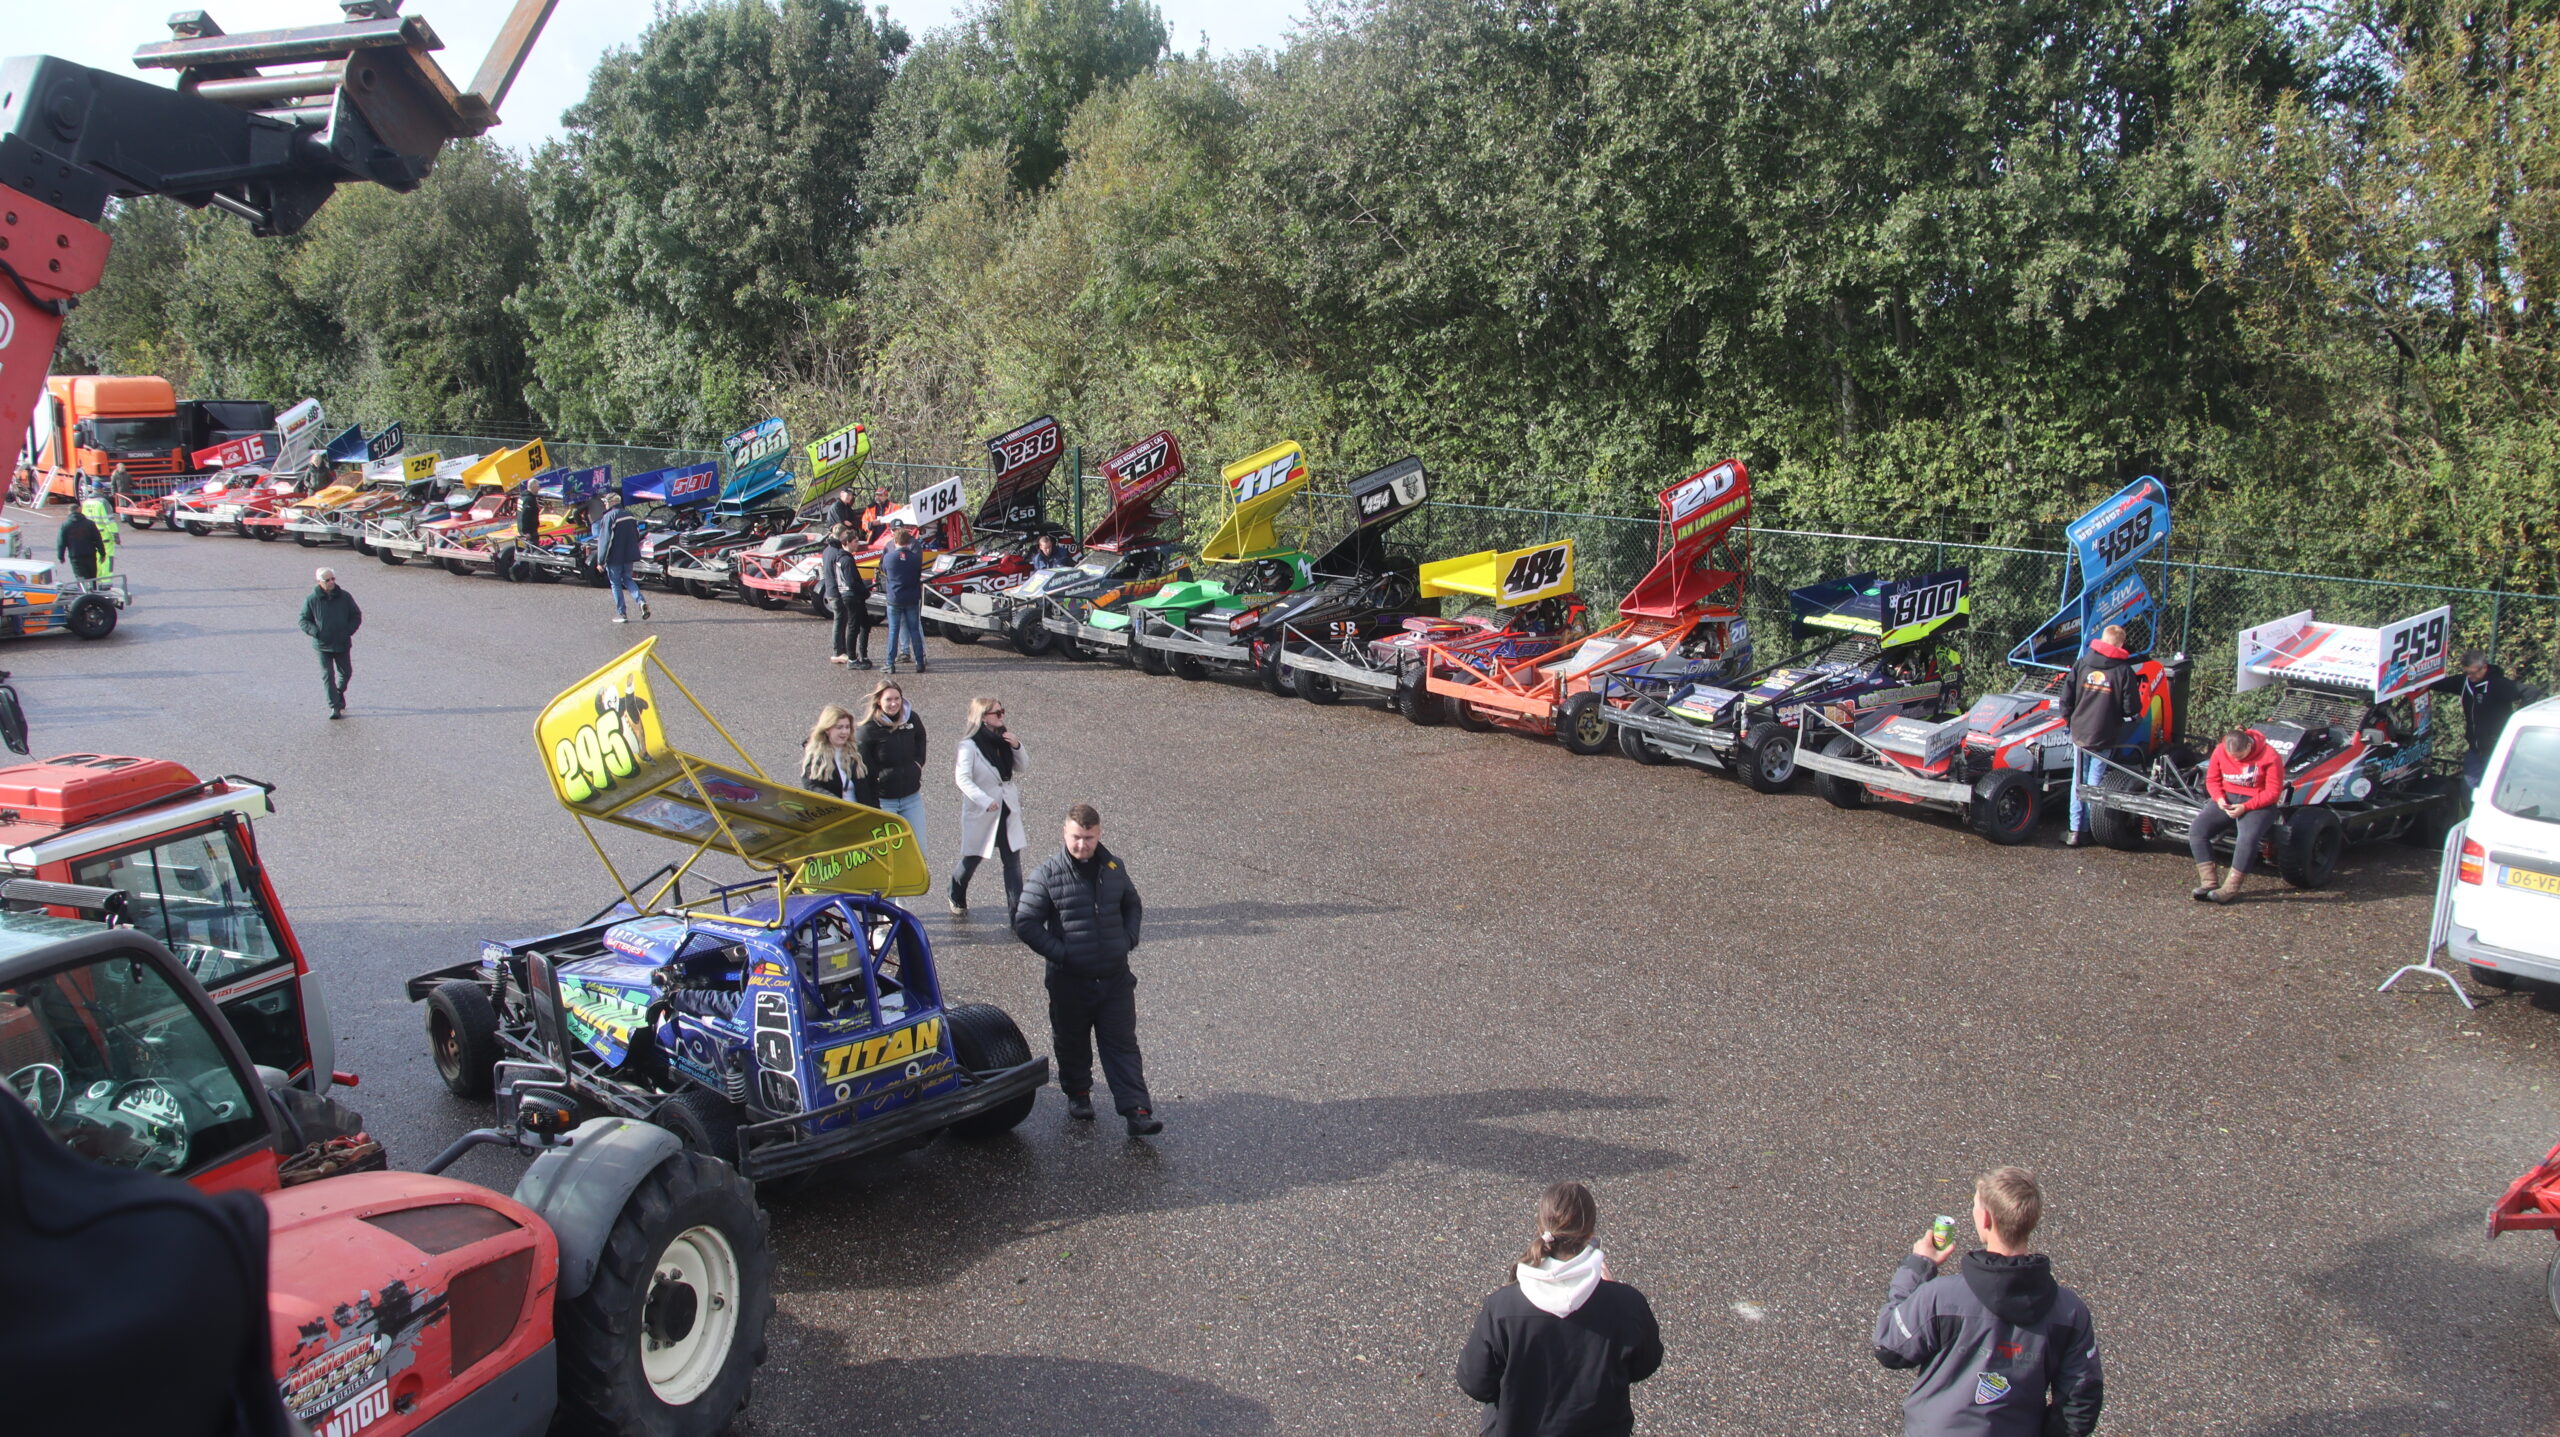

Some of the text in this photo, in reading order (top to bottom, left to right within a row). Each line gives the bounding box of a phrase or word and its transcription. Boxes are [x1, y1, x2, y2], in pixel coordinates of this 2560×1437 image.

[241, 436, 267, 462] 16
[413, 456, 434, 473] 297
[528, 444, 543, 472] 53
[1007, 426, 1057, 470] 236
[1117, 441, 1169, 490] 337
[671, 471, 713, 497] 591
[1236, 452, 1296, 503] 117
[919, 484, 958, 517] H 184
[1503, 544, 1569, 600] 484
[1731, 624, 1748, 644] 20
[2390, 615, 2445, 666] 259
[1681, 661, 1722, 675] ADMIN
[555, 708, 638, 803] 295
[823, 1016, 940, 1080] TITAN
